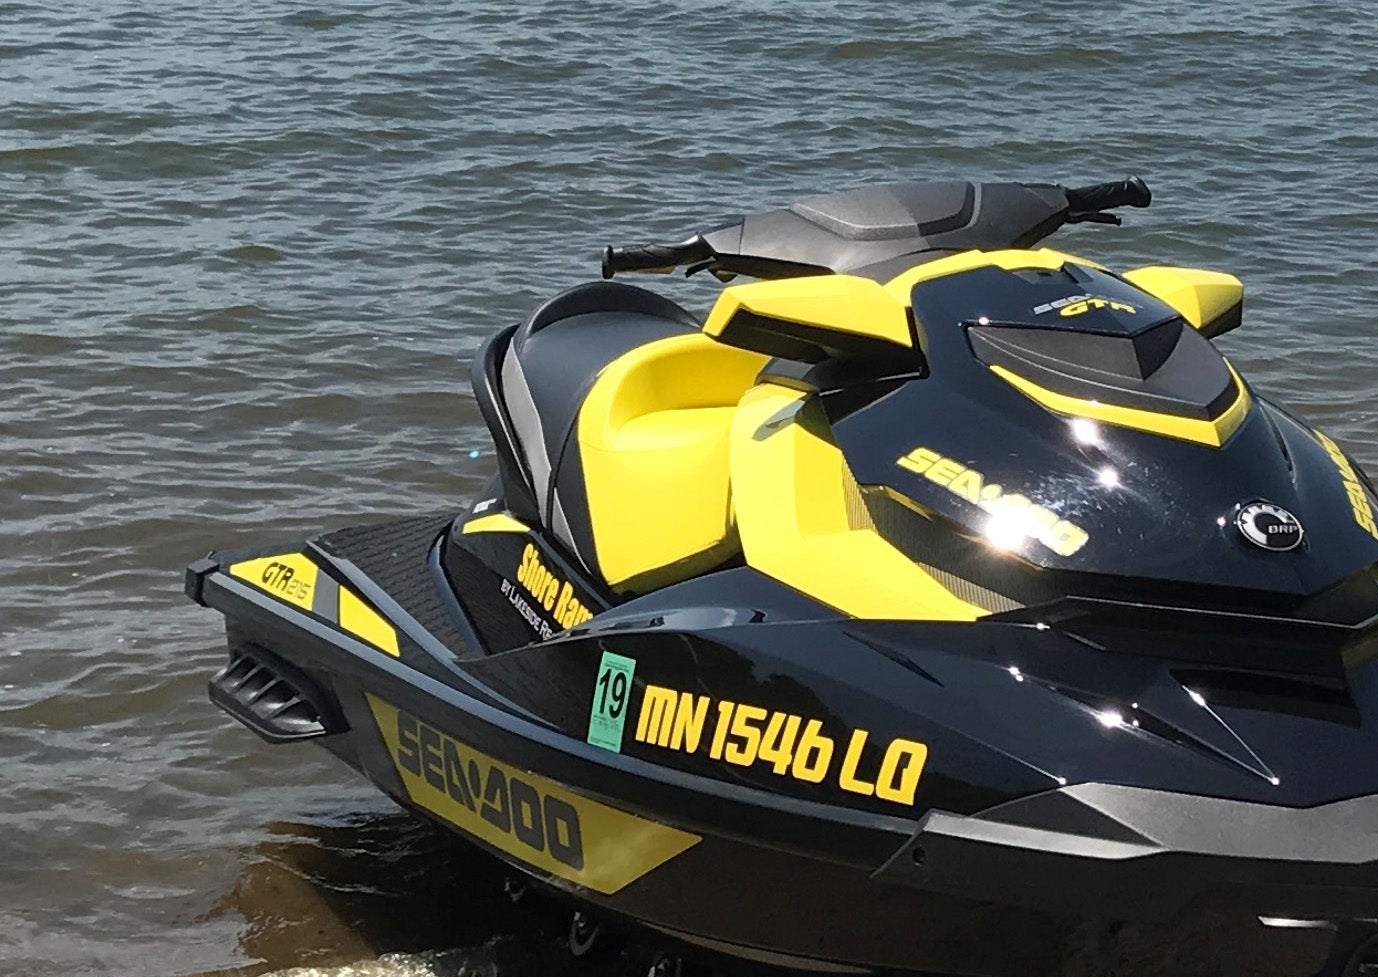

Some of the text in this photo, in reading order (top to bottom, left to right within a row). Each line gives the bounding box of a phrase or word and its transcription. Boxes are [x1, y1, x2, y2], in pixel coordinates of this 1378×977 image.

[262, 561, 295, 592] GTR
[516, 543, 560, 612] Shore
[599, 668, 627, 719] 19
[635, 685, 710, 754] MN
[709, 700, 834, 784] 1546
